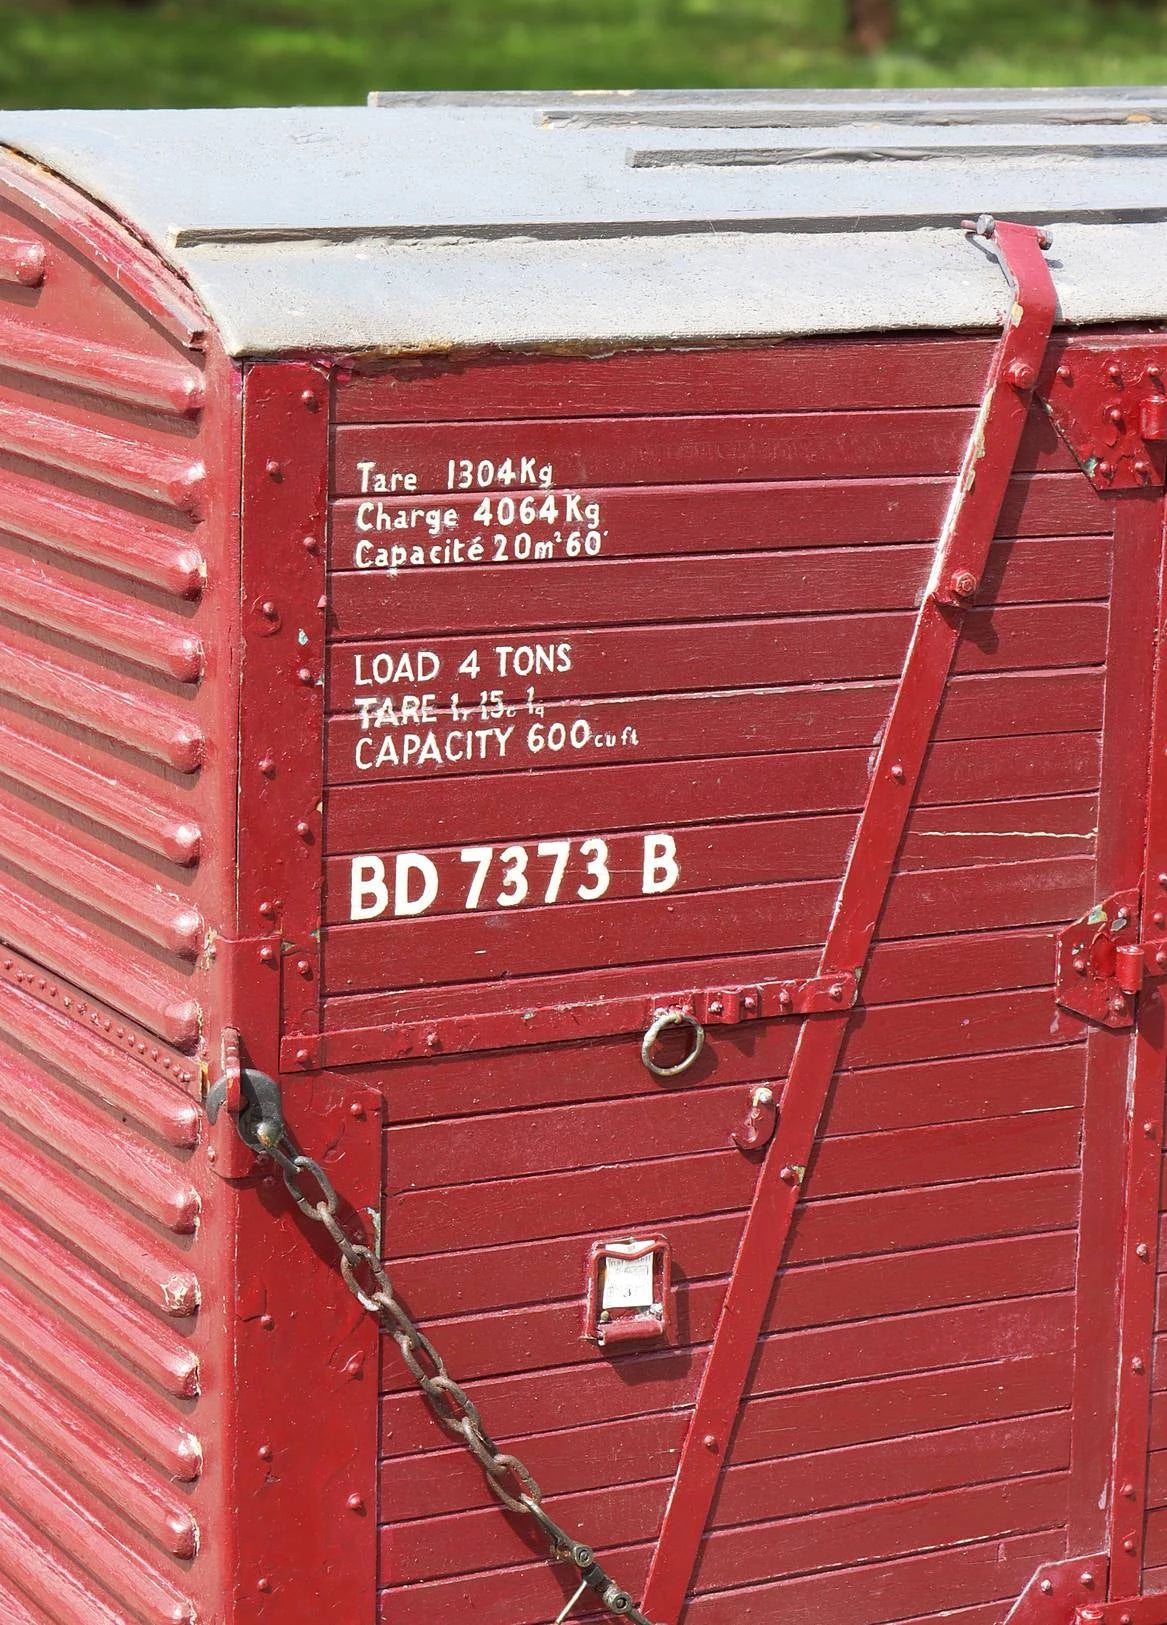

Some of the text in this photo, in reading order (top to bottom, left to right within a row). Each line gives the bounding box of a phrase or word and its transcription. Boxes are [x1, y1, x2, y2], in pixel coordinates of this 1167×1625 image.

[356, 461, 418, 493] Tare
[356, 502, 459, 535] Charge
[355, 536, 485, 576] Capacité
[354, 643, 573, 686] LOAD 4 TONS
[354, 694, 437, 730] TARE
[354, 726, 514, 770] CAPACITY
[350, 833, 680, 921] BD 7373 B
